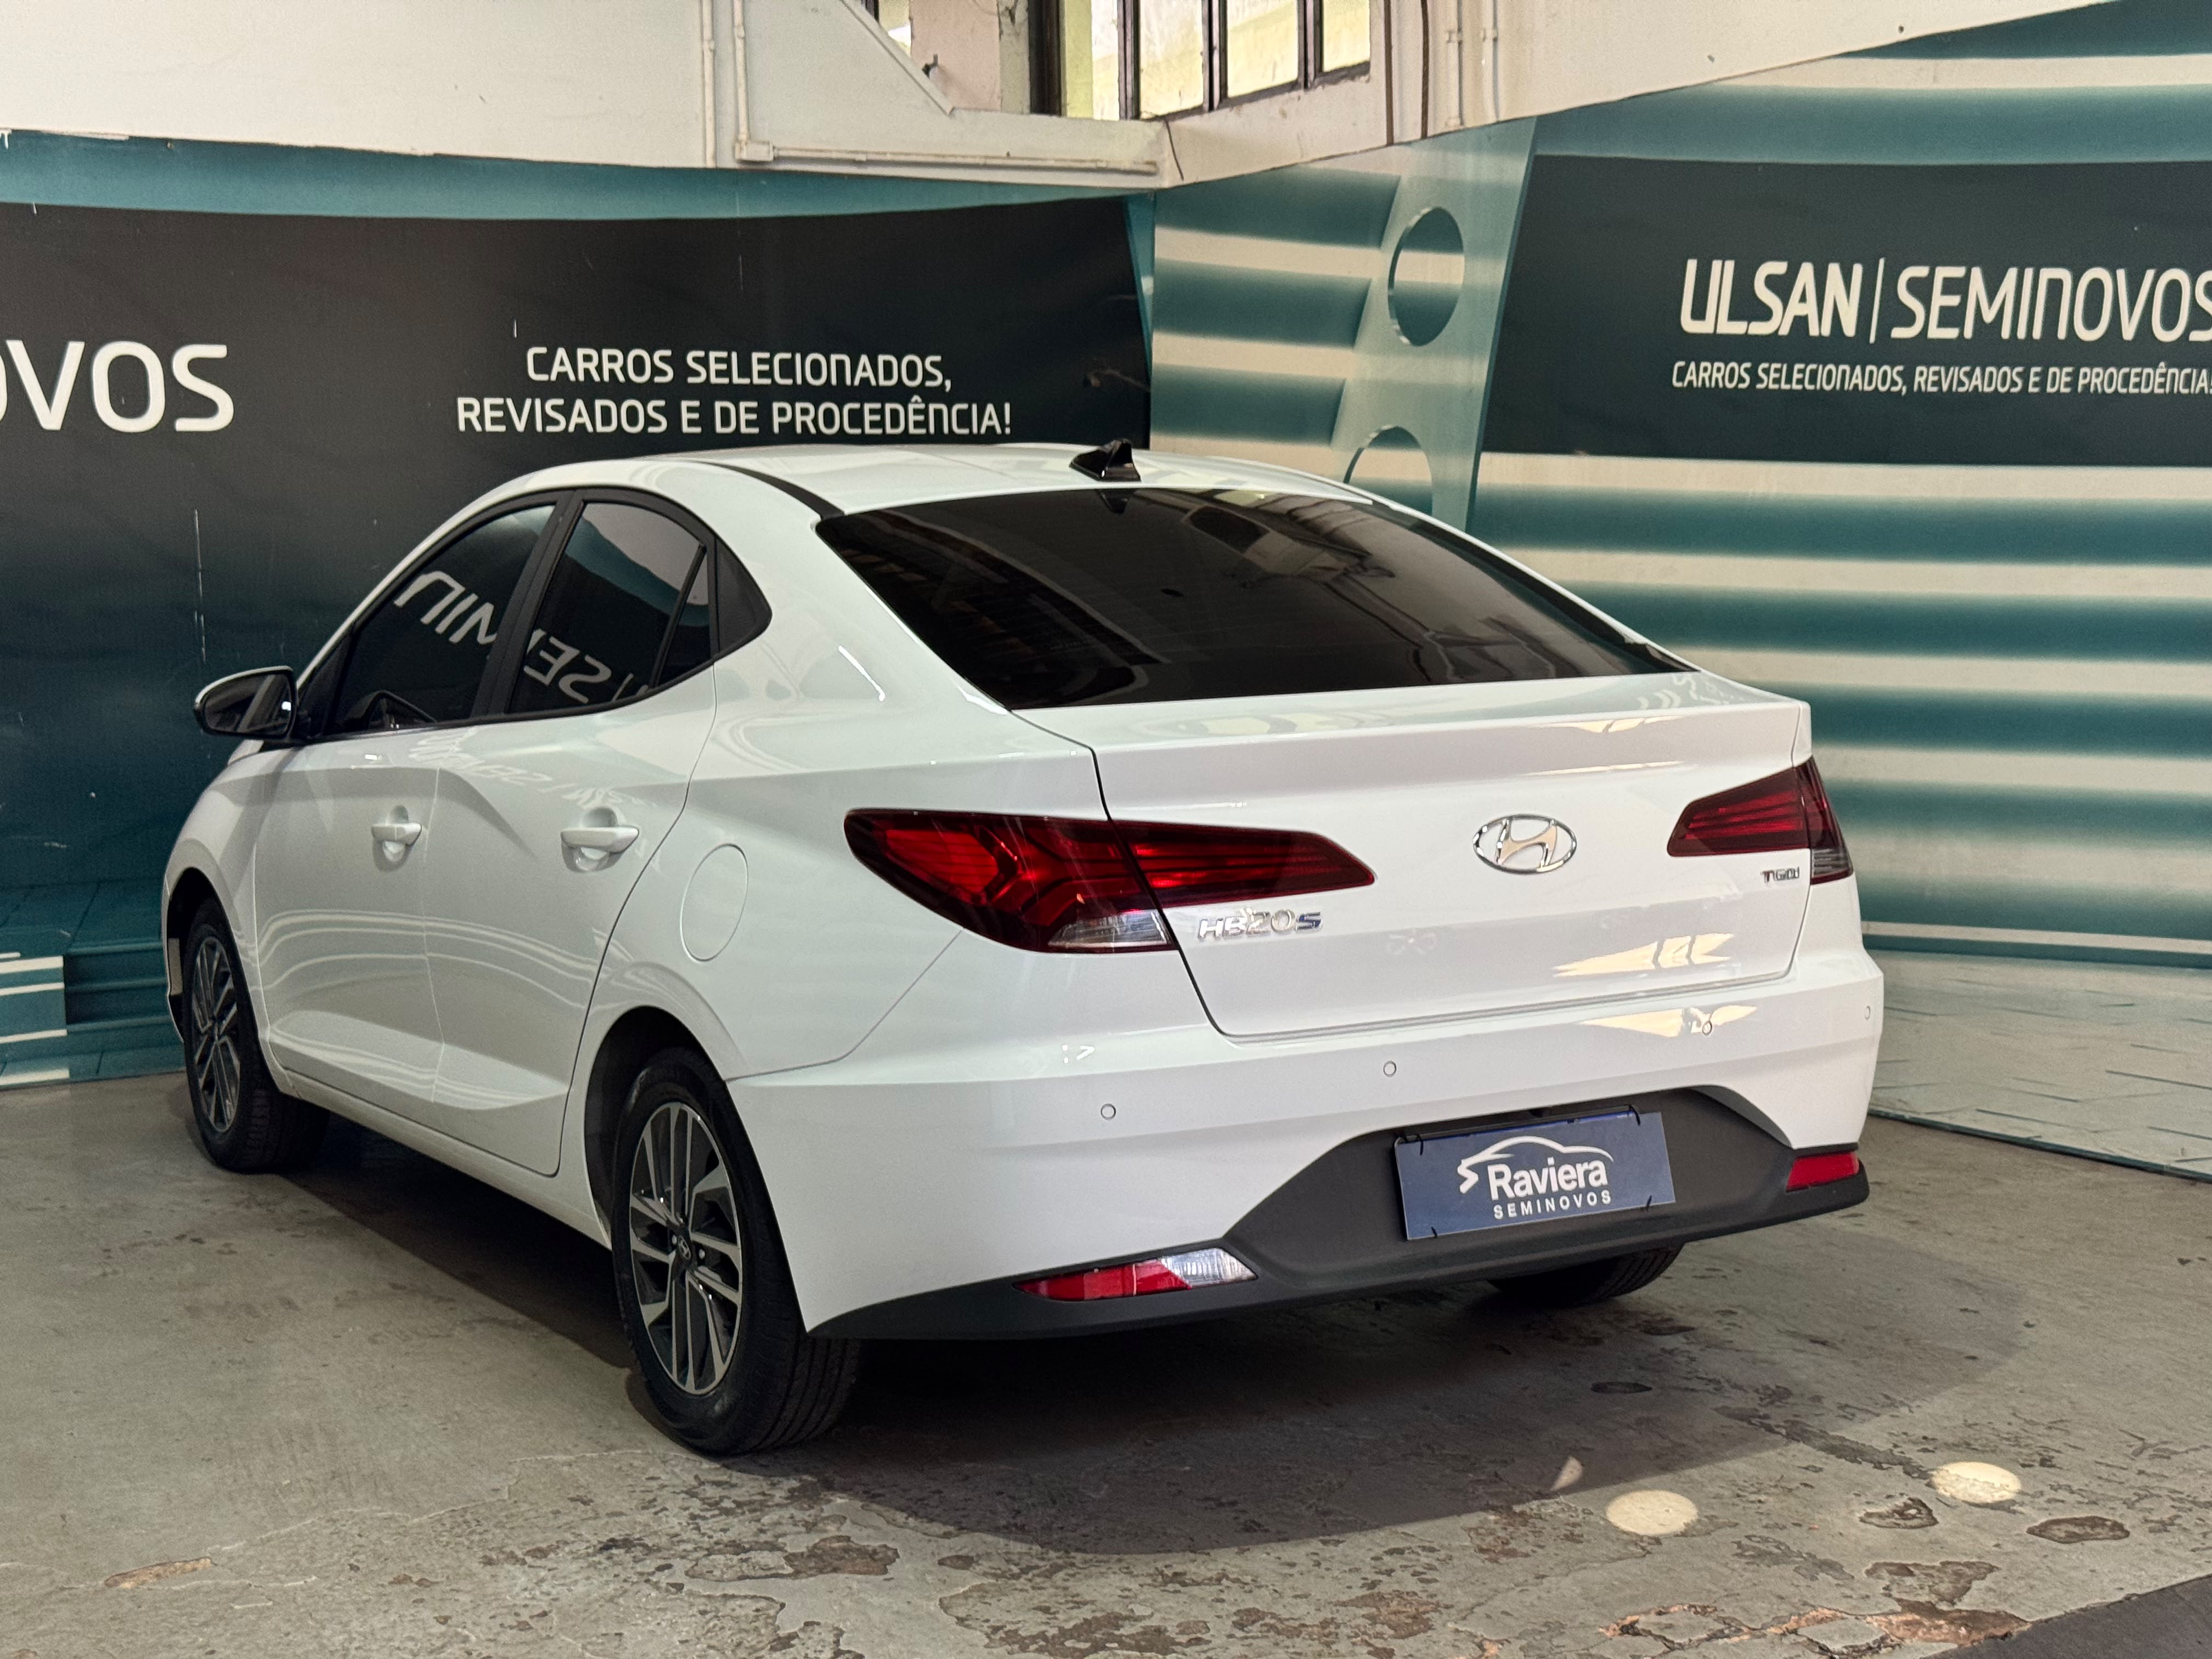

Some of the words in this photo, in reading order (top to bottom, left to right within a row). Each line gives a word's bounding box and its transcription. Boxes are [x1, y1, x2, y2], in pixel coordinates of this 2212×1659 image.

[1680, 259, 1863, 337] ULSAN
[1891, 266, 2212, 342] SEMINOVOS
[0, 340, 234, 433] VOS
[527, 347, 674, 383] CARROS
[686, 351, 951, 392] SELECIONADOS,
[1672, 361, 1752, 389] CARROS
[1756, 363, 1906, 396] SELECIONADOS,
[1914, 365, 2024, 393] REVISADOS
[2028, 366, 2042, 393] E
[2046, 366, 2074, 393] DE
[2078, 361, 2212, 394] PROCEDÊNCIA
[457, 397, 668, 433] REVISADOS
[681, 400, 702, 433] E
[715, 400, 759, 433] DE
[772, 395, 1011, 435] PROCEDÊNCIA!
[1197, 908, 1323, 940] HB20S
[1487, 1156, 1609, 1201] Raviera
[1493, 1189, 1612, 1220] SEMINOVOS
